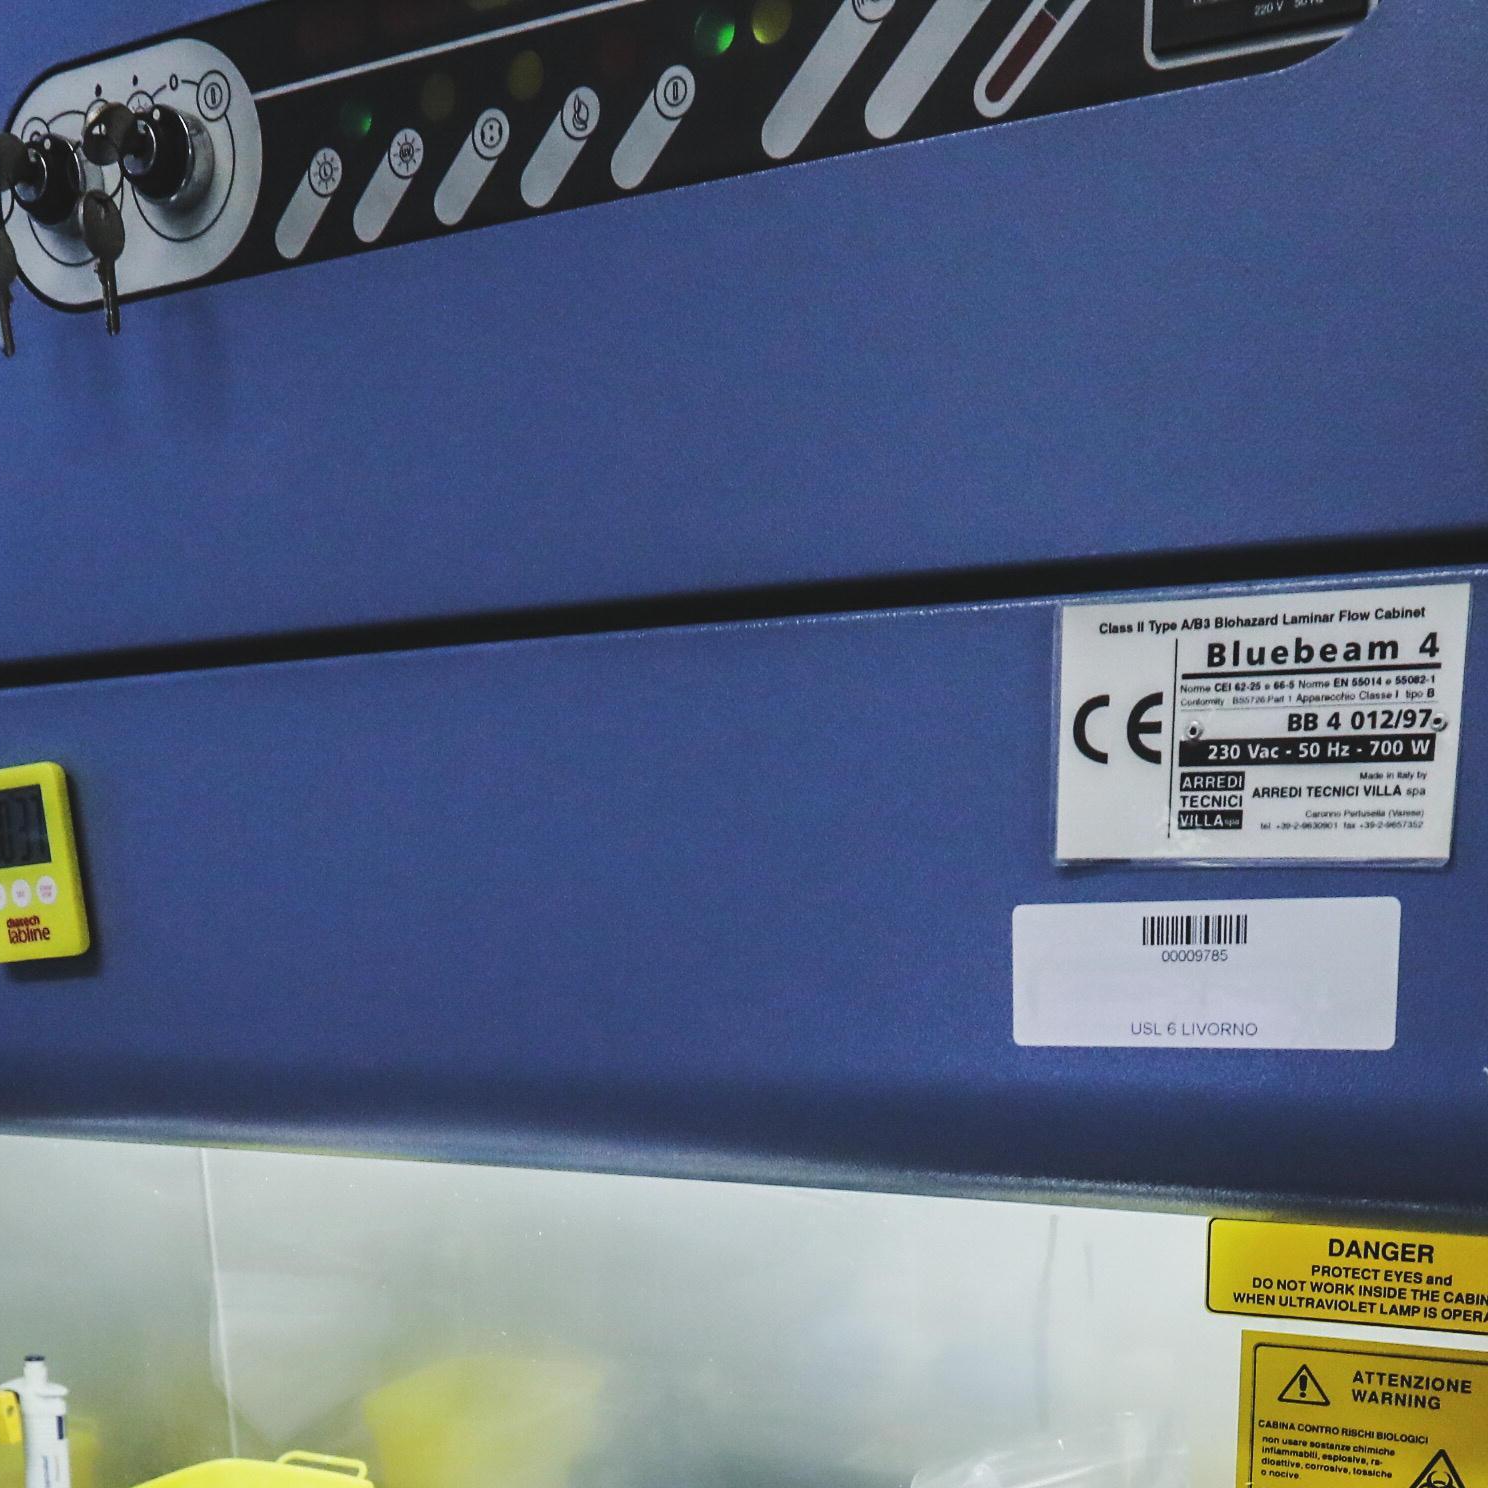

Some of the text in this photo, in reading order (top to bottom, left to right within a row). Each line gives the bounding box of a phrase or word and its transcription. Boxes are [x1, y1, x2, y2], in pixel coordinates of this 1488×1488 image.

[1099, 621, 1133, 634] Class
[1149, 619, 1177, 635] Type
[1181, 617, 1210, 631] A/B3
[1214, 614, 1278, 629] Biohazard
[1283, 612, 1335, 625] Laminar
[1339, 610, 1370, 622] Flow
[1375, 607, 1426, 620] Cabinet
[1207, 632, 1440, 668] Bluebeam 4
[1180, 683, 1211, 694] Norme
[1214, 682, 1232, 692] CEI
[1298, 679, 1330, 690] Norme
[1333, 677, 1349, 688] EN
[1296, 690, 1356, 704] Apparecchio
[1359, 690, 1392, 700] Classe
[1405, 688, 1424, 700] tipo
[1427, 688, 1435, 698] B
[1073, 692, 1164, 765] CE
[1288, 708, 1433, 732] BB 4 012/97
[1207, 739, 1431, 760] 230 Vac 50 Hz 700 W
[1181, 775, 1243, 790] ARREDI
[1359, 772, 1384, 780] Made
[1416, 771, 1427, 780] by
[1180, 794, 1243, 808] TECNICI
[1252, 784, 1426, 798] ARREDI TECNICI VILLA spa
[1179, 814, 1224, 828] VILLA
[7, 926, 51, 944] labline
[1162, 949, 1229, 962] 00009785
[1131, 1022, 1258, 1036] USL 6 LIVORNO
[1328, 1238, 1435, 1264] DANGER
[1311, 1265, 1453, 1286] PROTECT EYES and
[1252, 1277, 1274, 1290] DO
[1277, 1279, 1307, 1292] NOT
[1310, 1280, 1355, 1297] WORK
[1358, 1284, 1407, 1300] INSIDE
[1410, 1288, 1440, 1303] THE
[1233, 1292, 1276, 1306] WHEN
[1279, 1295, 1377, 1315] ULTRAVIOLET
[1379, 1302, 1420, 1317] LAMP
[1423, 1306, 1438, 1319] IS
[1352, 1370, 1473, 1395] ATTENZIONE
[1352, 1389, 1442, 1411] WARNING
[1258, 1419, 1429, 1445] CABINA CONTRO RISCHI BIOLOGICI
[1262, 1436, 1395, 1456] non usare sostanze chimiche
[1305, 1462, 1351, 1475] corrosive,
[1353, 1467, 1393, 1479] tossiche
